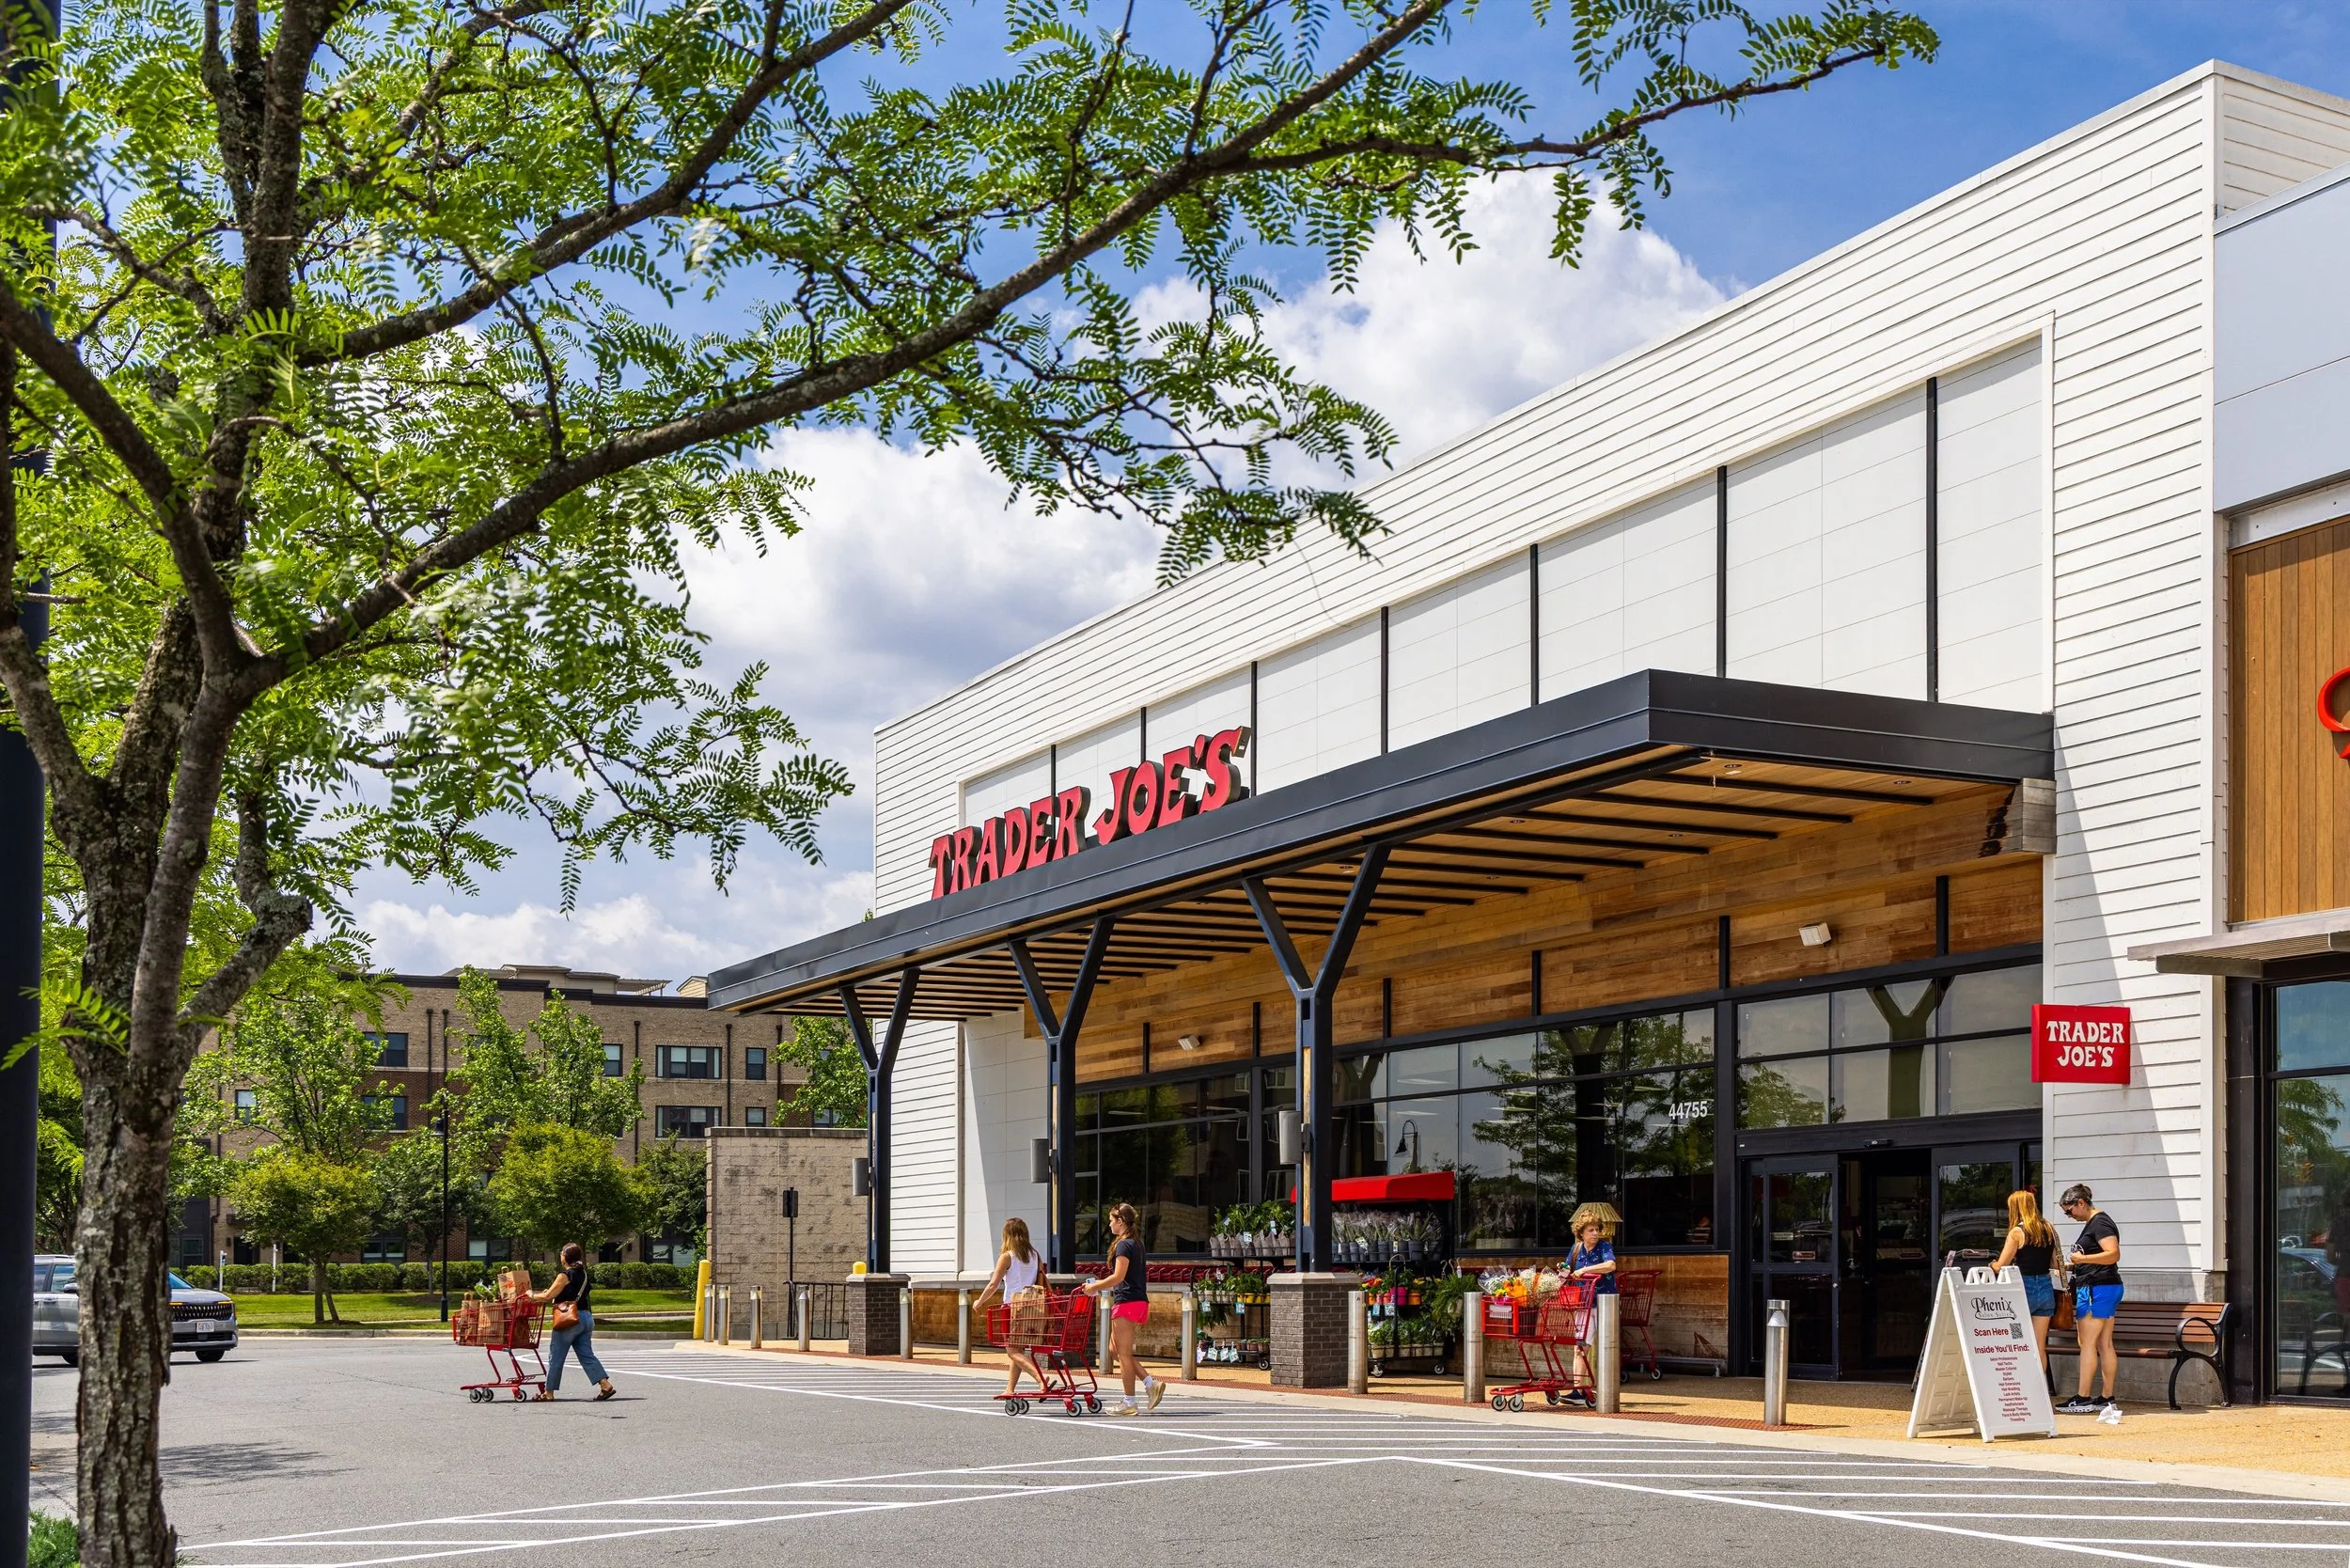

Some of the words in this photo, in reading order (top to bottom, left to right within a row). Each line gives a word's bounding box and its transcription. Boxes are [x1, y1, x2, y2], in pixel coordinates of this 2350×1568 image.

[929, 786, 1090, 901] TRADER
[1092, 726, 1252, 845] JOE'S
[2046, 1021, 2124, 1043] TRADER
[2057, 1045, 2115, 1067] JOE'S
[1668, 1100, 1708, 1121] 44755
[1971, 1297, 2014, 1314] Phenix
[1995, 1344, 2013, 1353] You'll
